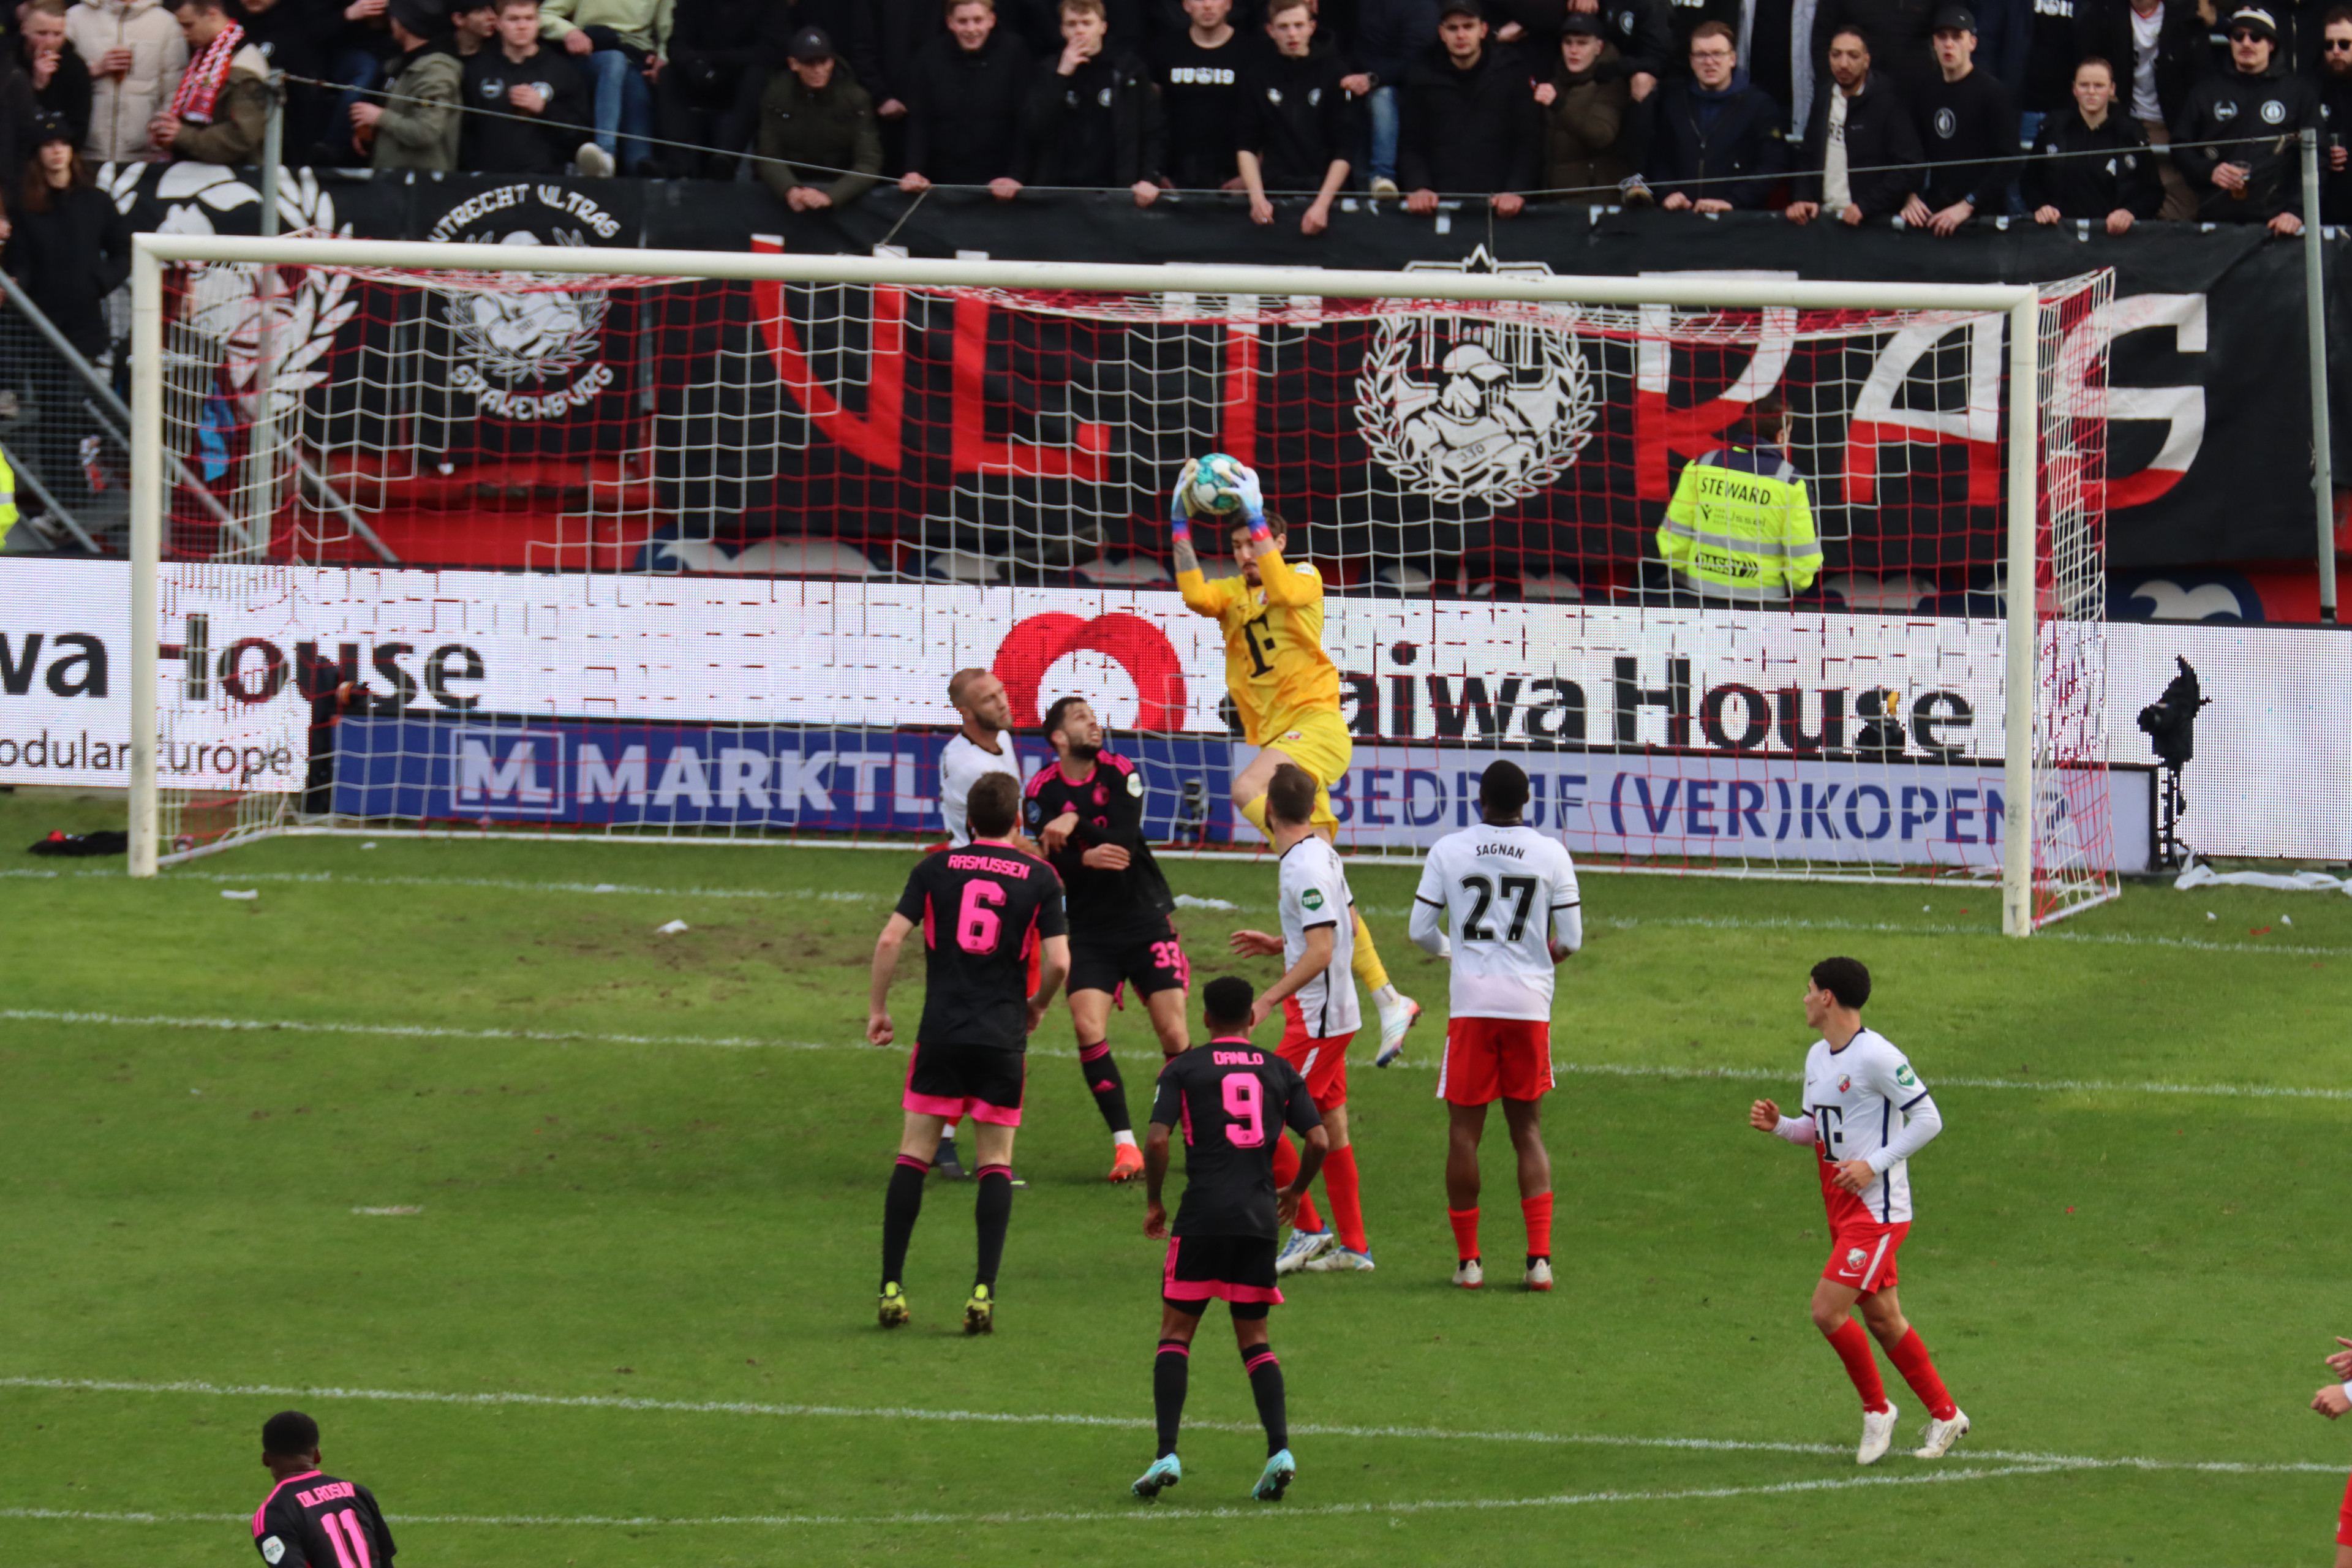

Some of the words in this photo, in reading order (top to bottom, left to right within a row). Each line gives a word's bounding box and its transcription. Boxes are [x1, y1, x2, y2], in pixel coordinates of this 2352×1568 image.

[428, 184, 529, 243] UTRECHT
[537, 184, 621, 238] ULTRAS
[449, 362, 614, 420] SPAKENBURG
[1701, 477, 1771, 505] STEWARD
[1339, 641, 1588, 742] aiwa
[157, 734, 292, 785] urope
[576, 744, 1044, 813] MARKTL
[1328, 769, 1587, 829] BEDRJF
[948, 854, 1030, 880] RASMUSSEN
[1476, 844, 1525, 859] SAGNAN
[956, 878, 1007, 956] 6
[1460, 873, 1539, 943] 27
[1150, 941, 1180, 968] 33
[1213, 1051, 1264, 1065] DANILO
[1221, 1072, 1265, 1148] 9
[295, 1482, 356, 1508] DILROSUN
[320, 1508, 372, 1568] 11
